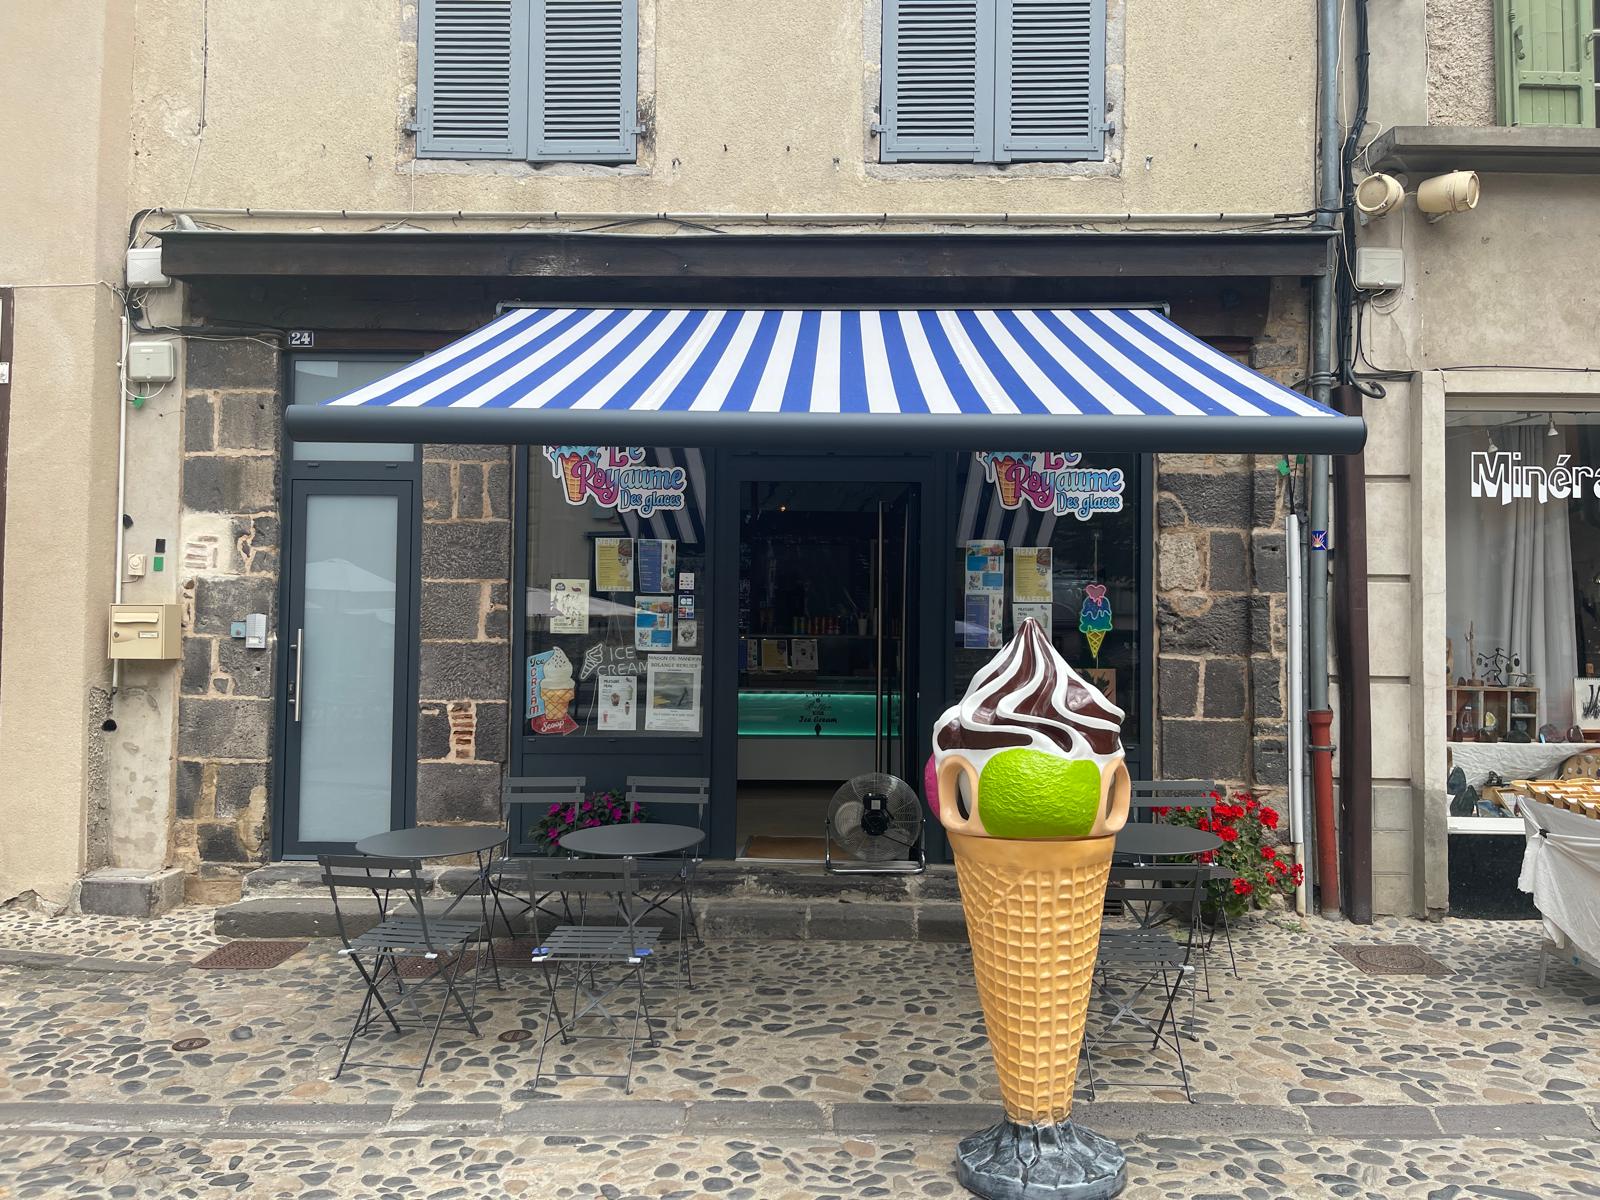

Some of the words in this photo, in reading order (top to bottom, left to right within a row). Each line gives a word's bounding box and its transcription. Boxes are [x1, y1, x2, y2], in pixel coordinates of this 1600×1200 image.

[291, 332, 311, 345] 24
[571, 460, 683, 504] Royaume
[1005, 463, 1120, 508] Royaume
[1471, 451, 1600, 505] Minér
[620, 489, 642, 509] Des
[641, 491, 681, 515] glaces
[1056, 492, 1079, 513] Des
[1079, 494, 1120, 518] glaces
[610, 646, 635, 661] ICE
[530, 668, 539, 715] CREAM
[541, 720, 564, 732] Scoop
